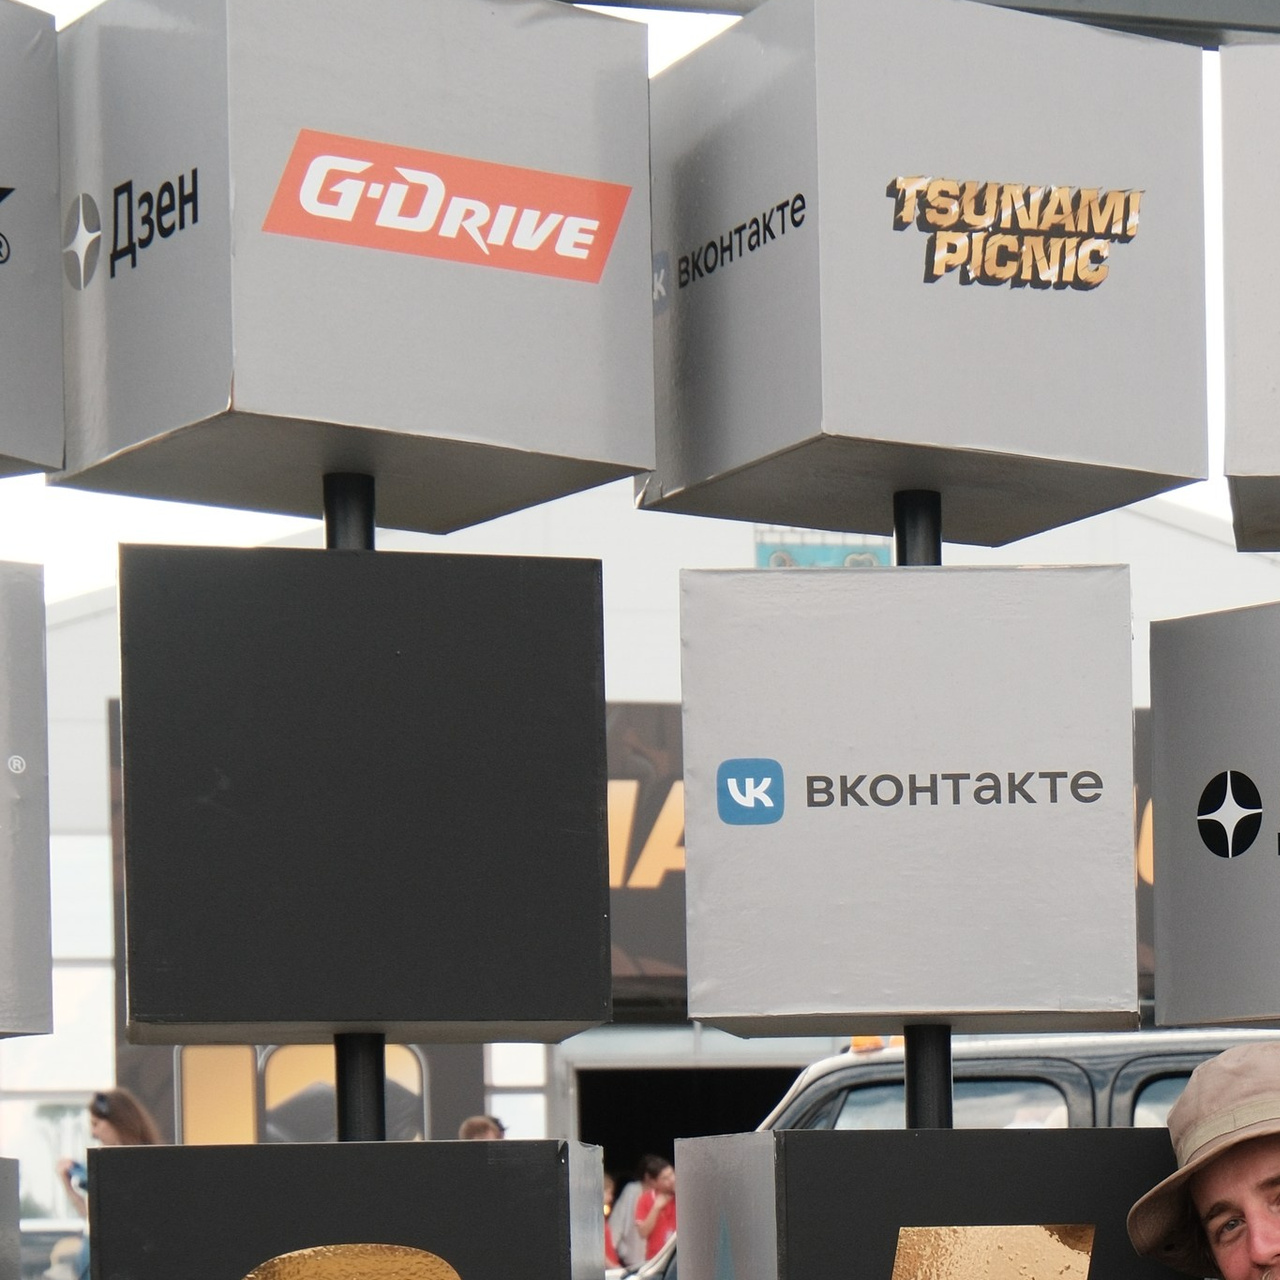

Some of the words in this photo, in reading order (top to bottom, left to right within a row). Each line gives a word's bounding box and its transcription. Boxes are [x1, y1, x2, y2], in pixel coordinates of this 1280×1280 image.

[110, 168, 198, 278] Дзен
[678, 193, 806, 289] вконтакте
[886, 174, 1146, 243] TSUNAMI
[923, 231, 1111, 291] PICNIC
[806, 769, 1103, 808] вконтакте
